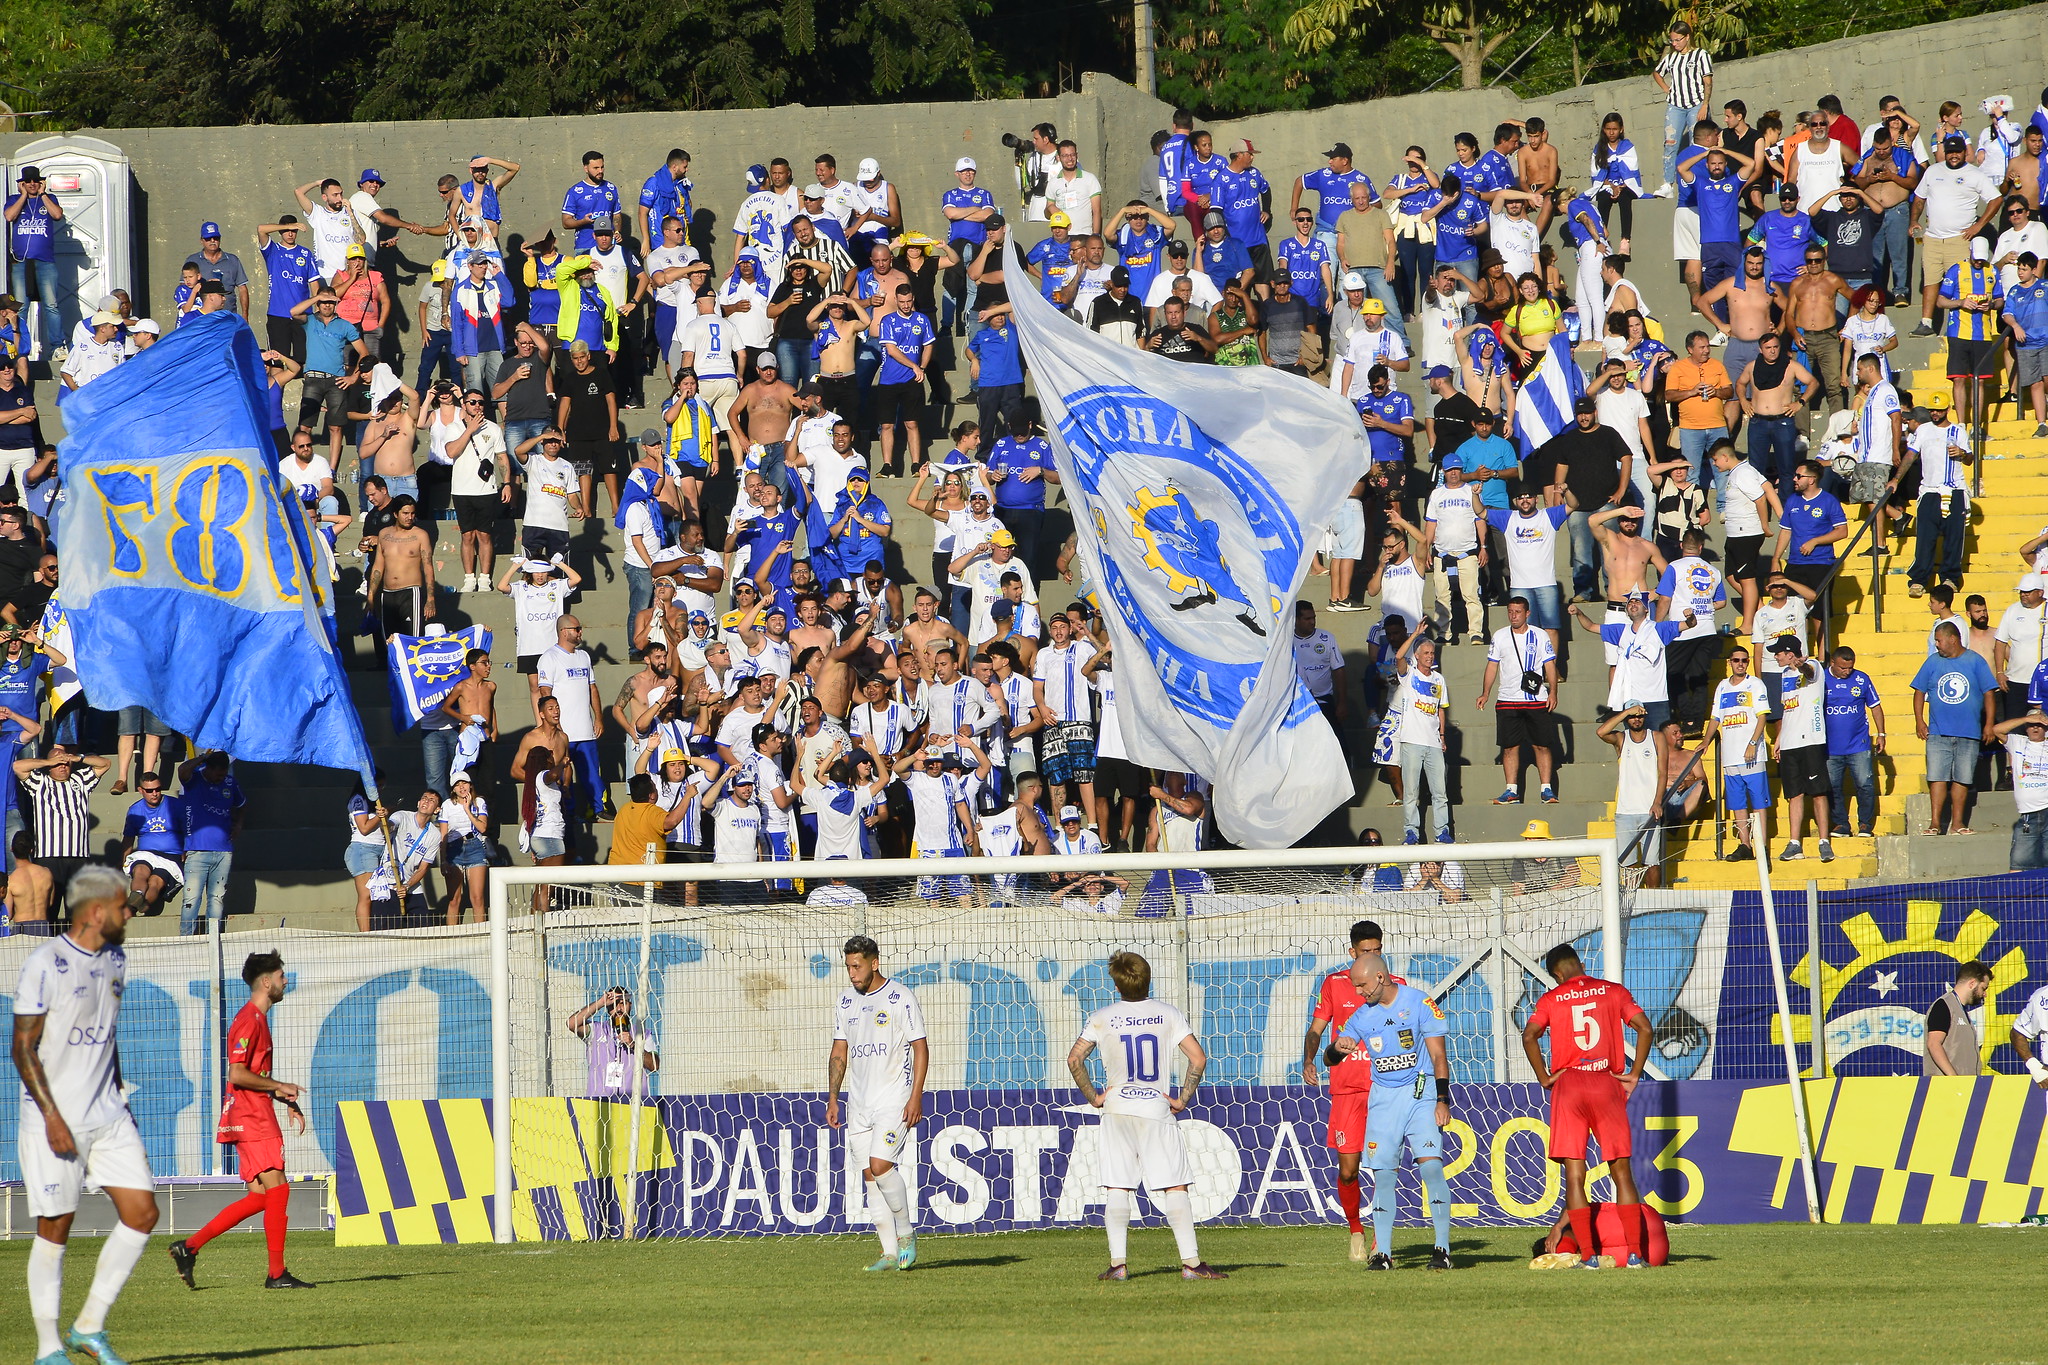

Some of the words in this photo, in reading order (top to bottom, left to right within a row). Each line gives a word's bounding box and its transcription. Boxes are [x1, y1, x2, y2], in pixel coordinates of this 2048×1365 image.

[745, 195, 776, 210] TORCIDA
[1438, 223, 1465, 237] OSCAR
[1290, 270, 1318, 281] OSCA
[579, 303, 603, 314] OSCA
[708, 322, 721, 352] 8
[896, 344, 919, 355] SCAR
[526, 612, 558, 622] OSCAR
[419, 655, 433, 664] SÃO
[434, 652, 451, 663] JOSÉ
[420, 691, 445, 711] ÁGUIA
[1826, 704, 1858, 716] OSCAR
[1722, 710, 1749, 727] SPANI
[1813, 703, 1821, 733] SICOOB
[1555, 985, 1607, 1003] nobrand
[1125, 1014, 1164, 1026] Sicredi
[1570, 1002, 1601, 1052] 5
[1880, 1015, 1924, 1043] OSÉ
[851, 1043, 888, 1059] OSCAR
[1119, 1033, 1160, 1082] 10
[1375, 1052, 1418, 1067] ODONTO
[1376, 1059, 1417, 1074] company
[1592, 1058, 1609, 1072] PRO
[1250, 1120, 1375, 1219] A
[1422, 1115, 1705, 1219] 203
